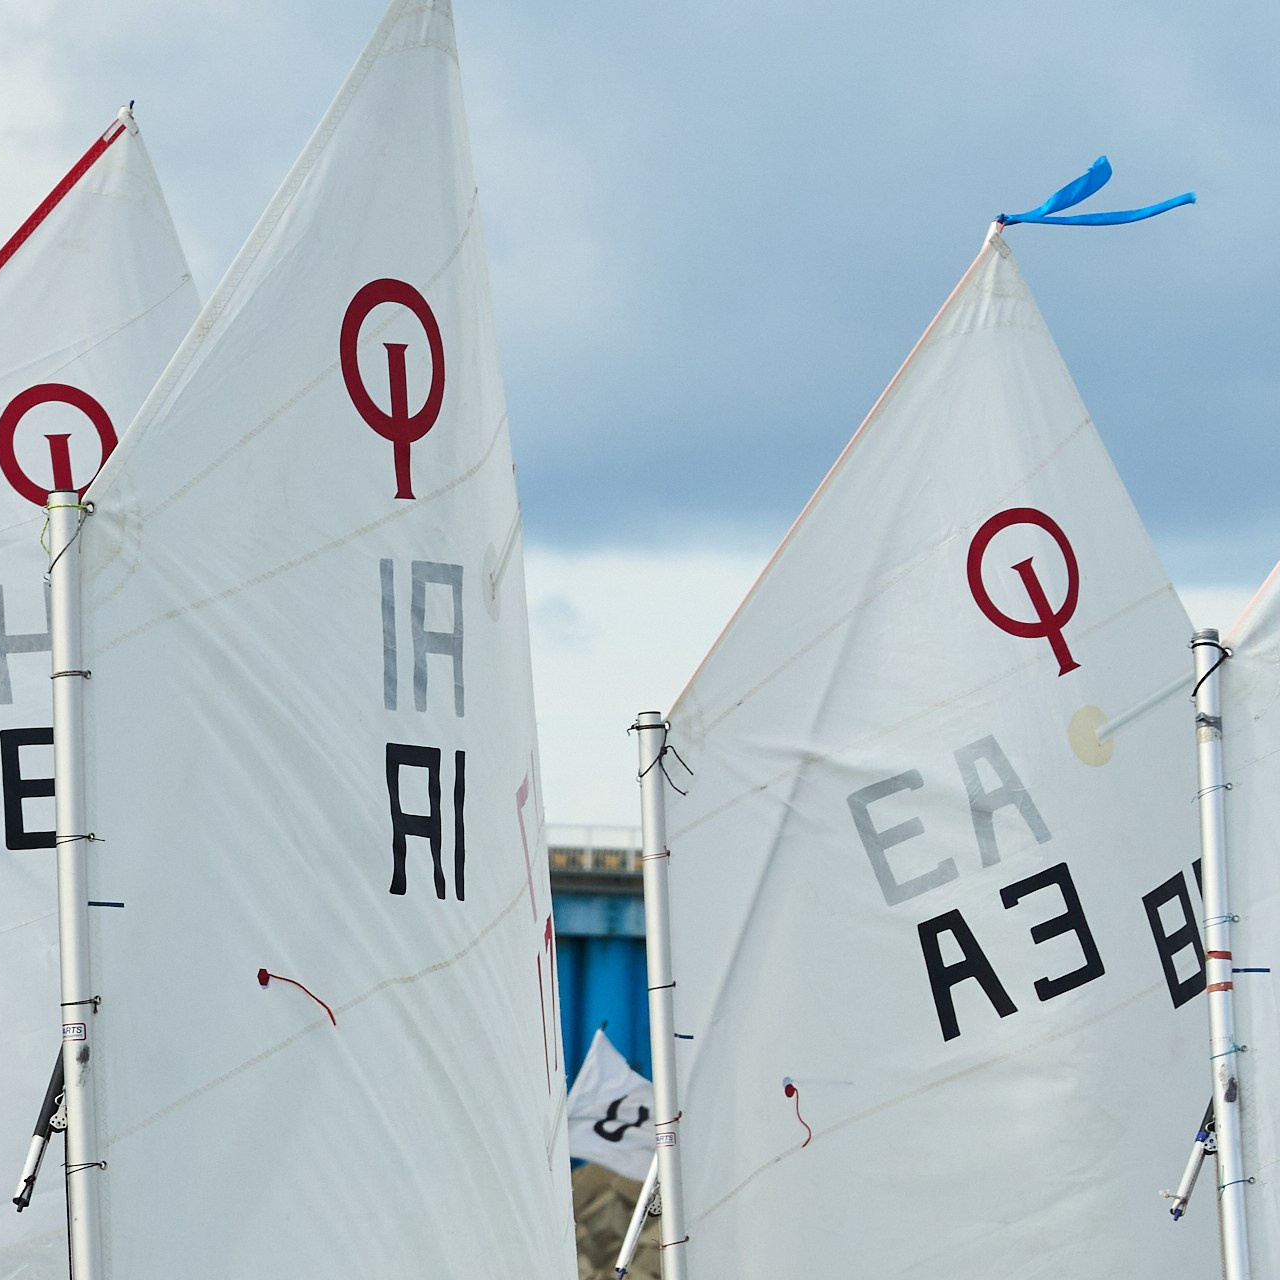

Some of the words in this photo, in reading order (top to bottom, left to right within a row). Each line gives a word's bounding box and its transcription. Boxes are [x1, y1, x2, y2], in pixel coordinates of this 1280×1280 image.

[386, 742, 465, 901] A1
[917, 862, 1105, 1042] A3
[1142, 858, 1207, 1009] B
